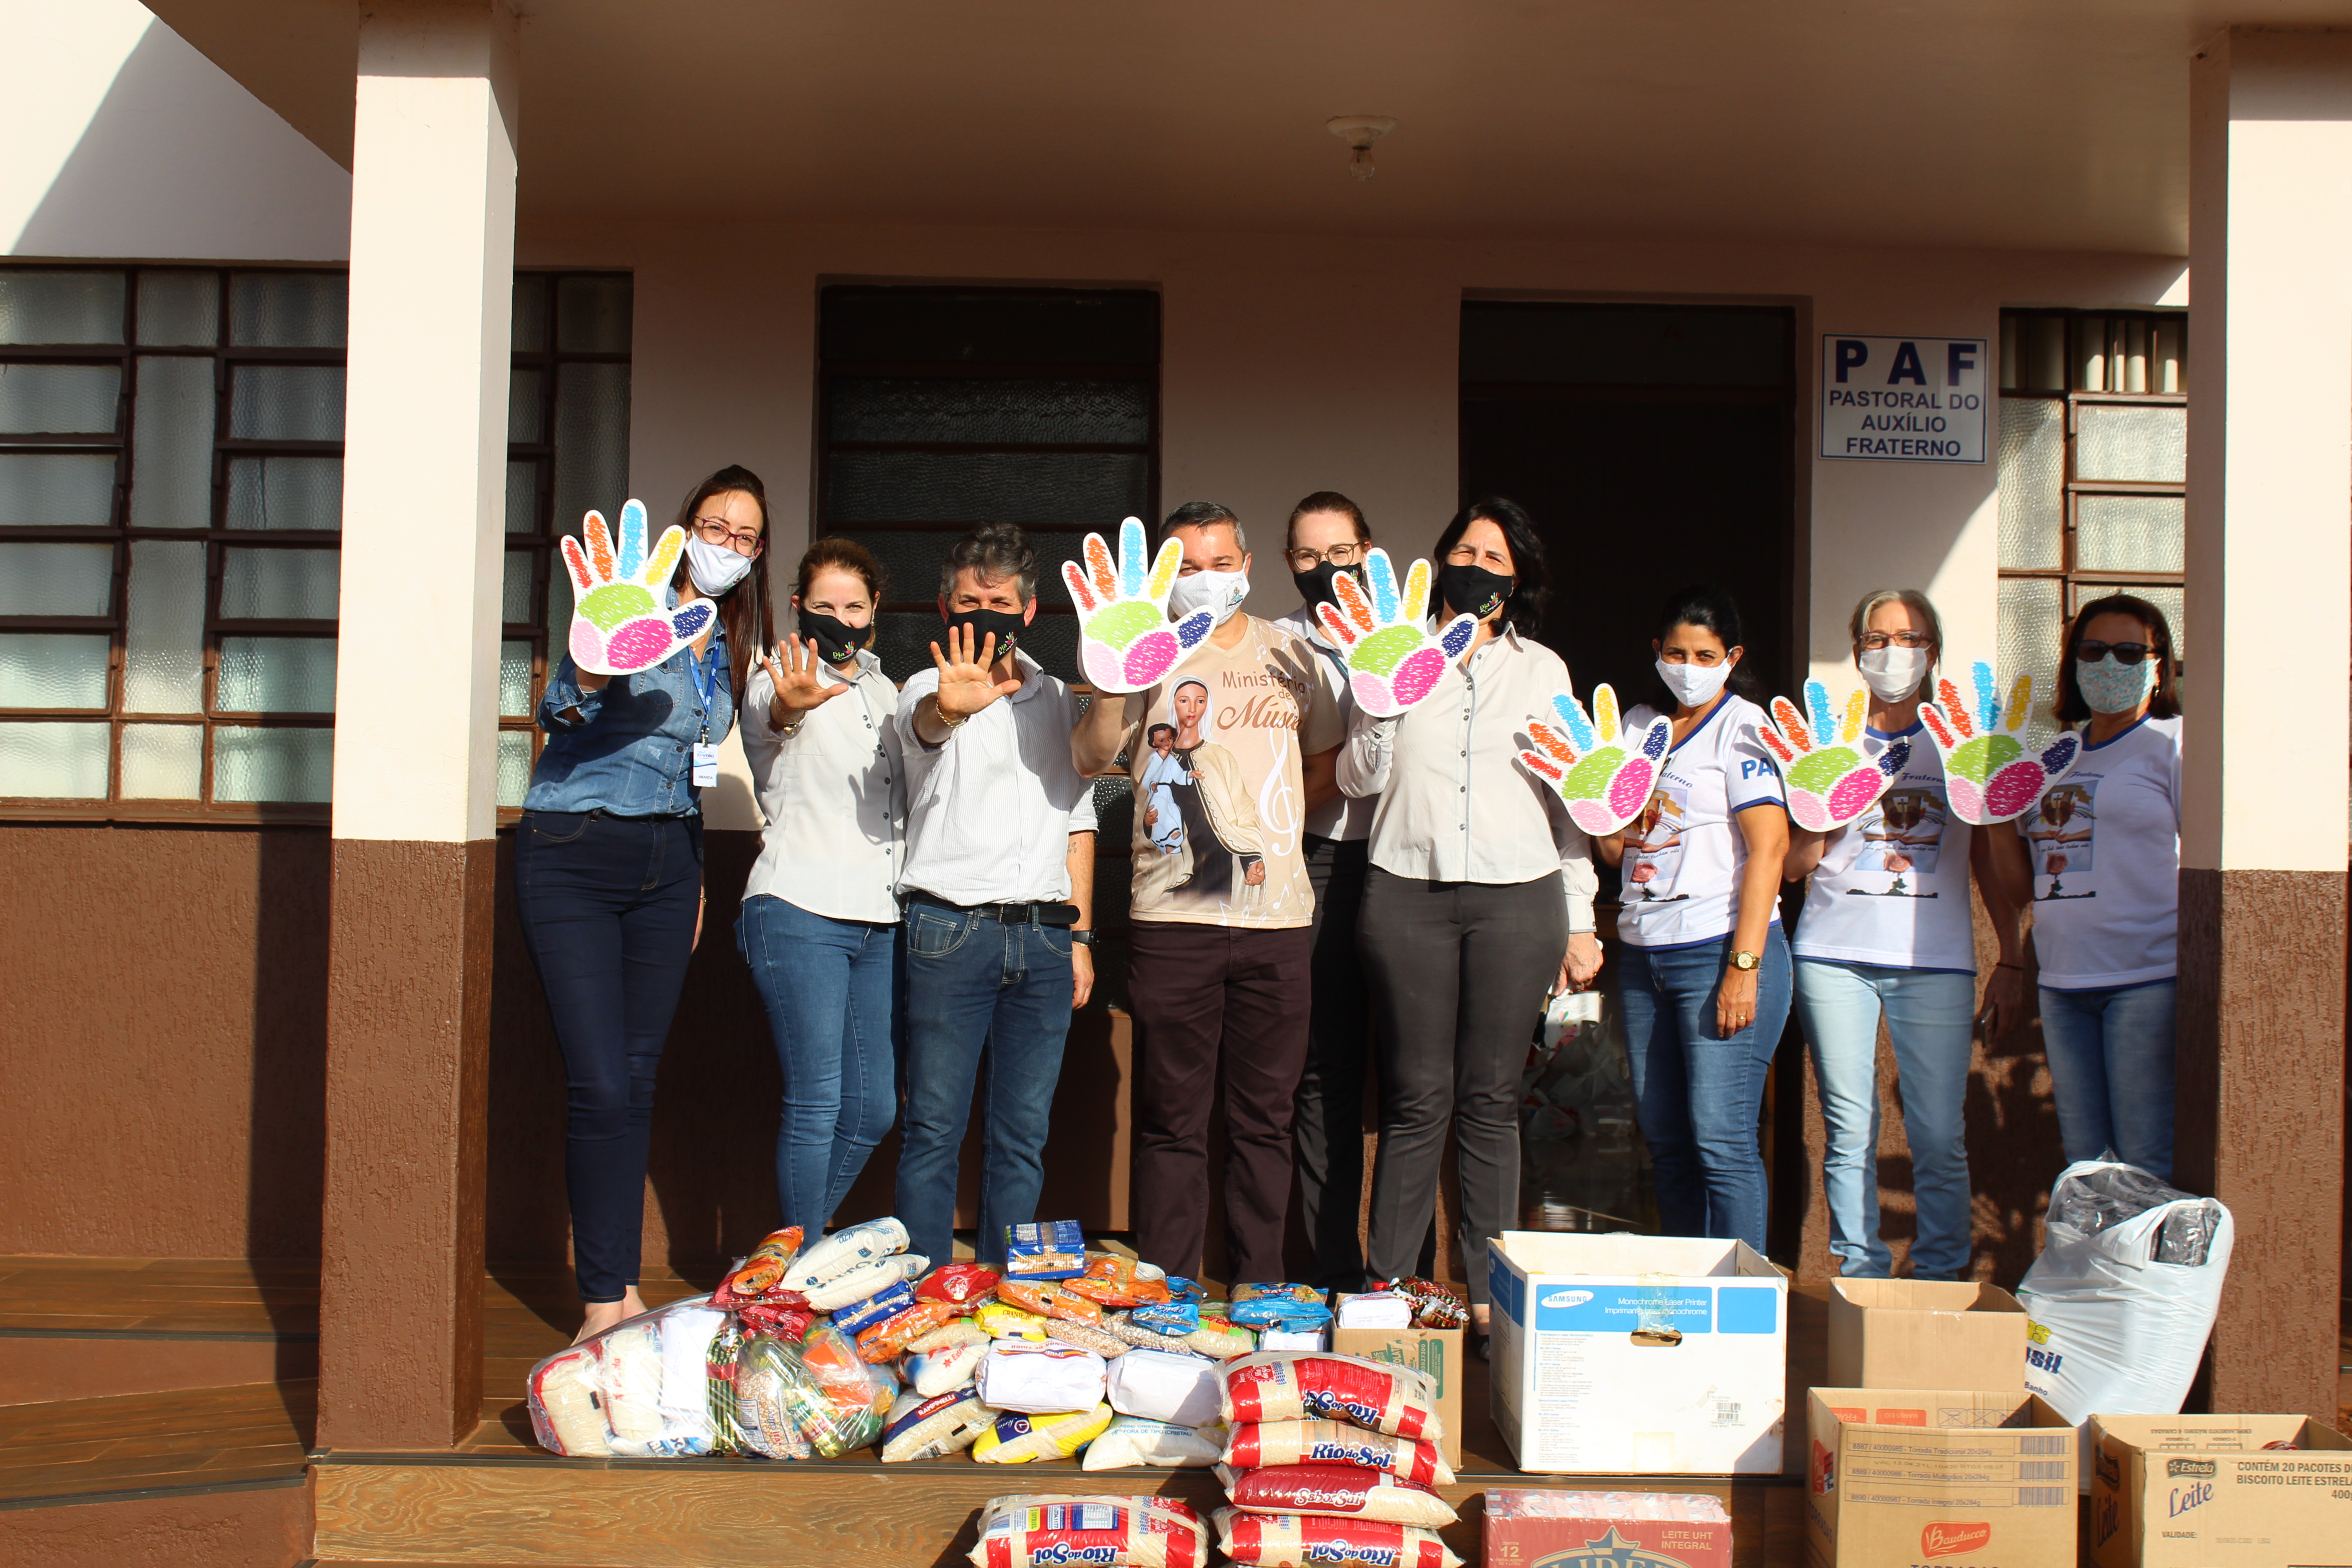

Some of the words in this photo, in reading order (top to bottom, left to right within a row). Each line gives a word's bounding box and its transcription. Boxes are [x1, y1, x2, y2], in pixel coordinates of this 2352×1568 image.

[1836, 340, 1868, 383] P
[1887, 342, 1927, 386] A
[1947, 343, 1977, 387] F
[1830, 390, 1942, 409] PASTORAL
[1949, 393, 1980, 410] DO
[1861, 412, 1947, 433] AUXÍLIO
[1846, 437, 1961, 456] FRATERNO
[1223, 671, 1305, 694] Ministério
[1278, 688, 1292, 700] de
[1741, 758, 1780, 780] PA
[1618, 1298, 1663, 1306] Monochrome
[951, 1342, 969, 1362] Estrel
[2024, 1381, 2048, 1396] Banho
[918, 1393, 956, 1416] RAMPINELLI
[1331, 1401, 1345, 1410] do
[1345, 1401, 1379, 1425] Rio
[1311, 1443, 1346, 1460] Rio
[1345, 1450, 1358, 1459] do
[1357, 1446, 1390, 1468] Sol
[1852, 1468, 1867, 1476] 8889
[1872, 1469, 1903, 1478] 40000986
[1932, 1472, 1964, 1480] Multigrãos
[1964, 1473, 1990, 1481] 20x284g
[2180, 1462, 2215, 1474] Estrela
[2238, 1460, 2279, 1472] CONTÉM
[2282, 1463, 2295, 1472] 20
[2297, 1463, 2342, 1473] PACOTES
[2237, 1475, 2283, 1485] BISCOITO
[2286, 1475, 2312, 1485] LEITE
[1871, 1494, 1901, 1503] 40000987
[1932, 1498, 1954, 1506] Integral
[1955, 1499, 1981, 1507] 20x284g
[2169, 1481, 2215, 1519] Leite
[1661, 1530, 1690, 1539] LEITE
[1692, 1532, 1713, 1540] UHT
[1929, 1526, 1987, 1550] Bauducco
[2162, 1530, 2197, 1539] VALIDADE:
[1309, 1540, 1349, 1561] Sol
[1344, 1549, 1361, 1558] do
[1500, 1546, 1519, 1558] 12
[1661, 1541, 1712, 1550] INTEGRAL
[1035, 1544, 1069, 1564] Sol
[1067, 1550, 1083, 1560] do
[1083, 1547, 1118, 1563] Rio
[1360, 1549, 1395, 1566] Rio
